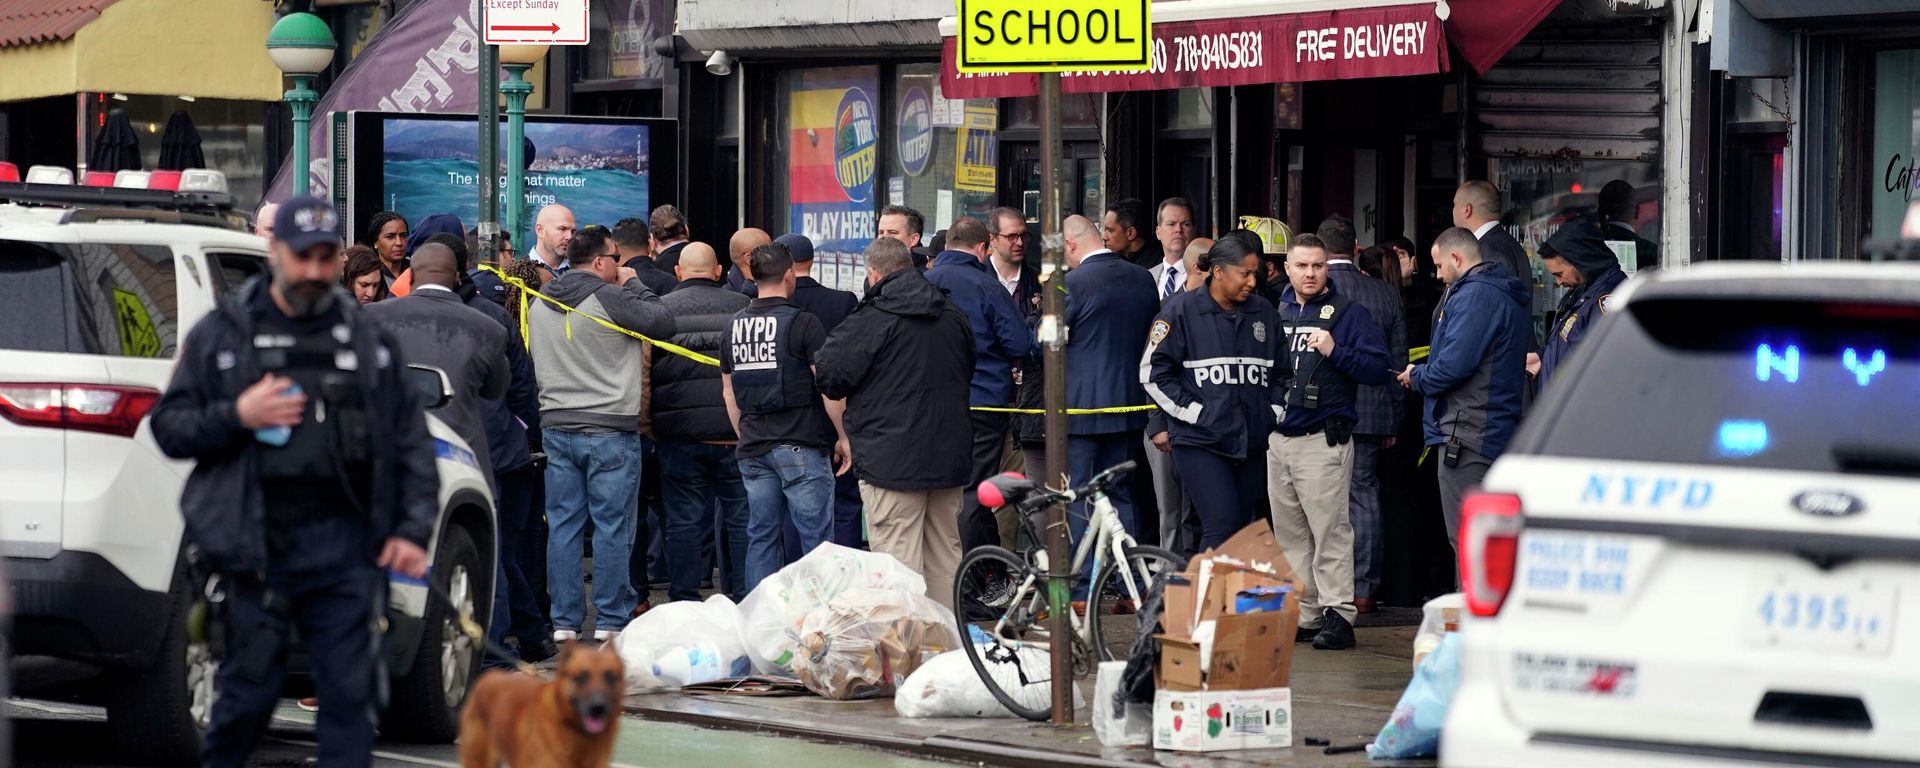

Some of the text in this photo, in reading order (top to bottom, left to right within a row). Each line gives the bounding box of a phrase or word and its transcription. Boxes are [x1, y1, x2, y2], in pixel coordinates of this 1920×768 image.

[491, 0, 559, 11] Except Sunday
[973, 9, 1136, 46] SCHOOL
[1174, 30, 1263, 72] 718-8405831
[1296, 27, 1338, 62] FREE
[1344, 21, 1427, 59] DELIVERY
[853, 101, 869, 118] NEW
[854, 120, 874, 147] YORK
[964, 129, 997, 167] ATM
[448, 172, 472, 185] The
[545, 176, 586, 187] matter
[803, 210, 876, 240] PLAY HERE
[732, 316, 777, 344] NYPD
[732, 342, 777, 363] POLICE
[1194, 365, 1268, 388] POLICE
[1581, 474, 1714, 509] NYPD
[1759, 592, 1848, 631] 4395
